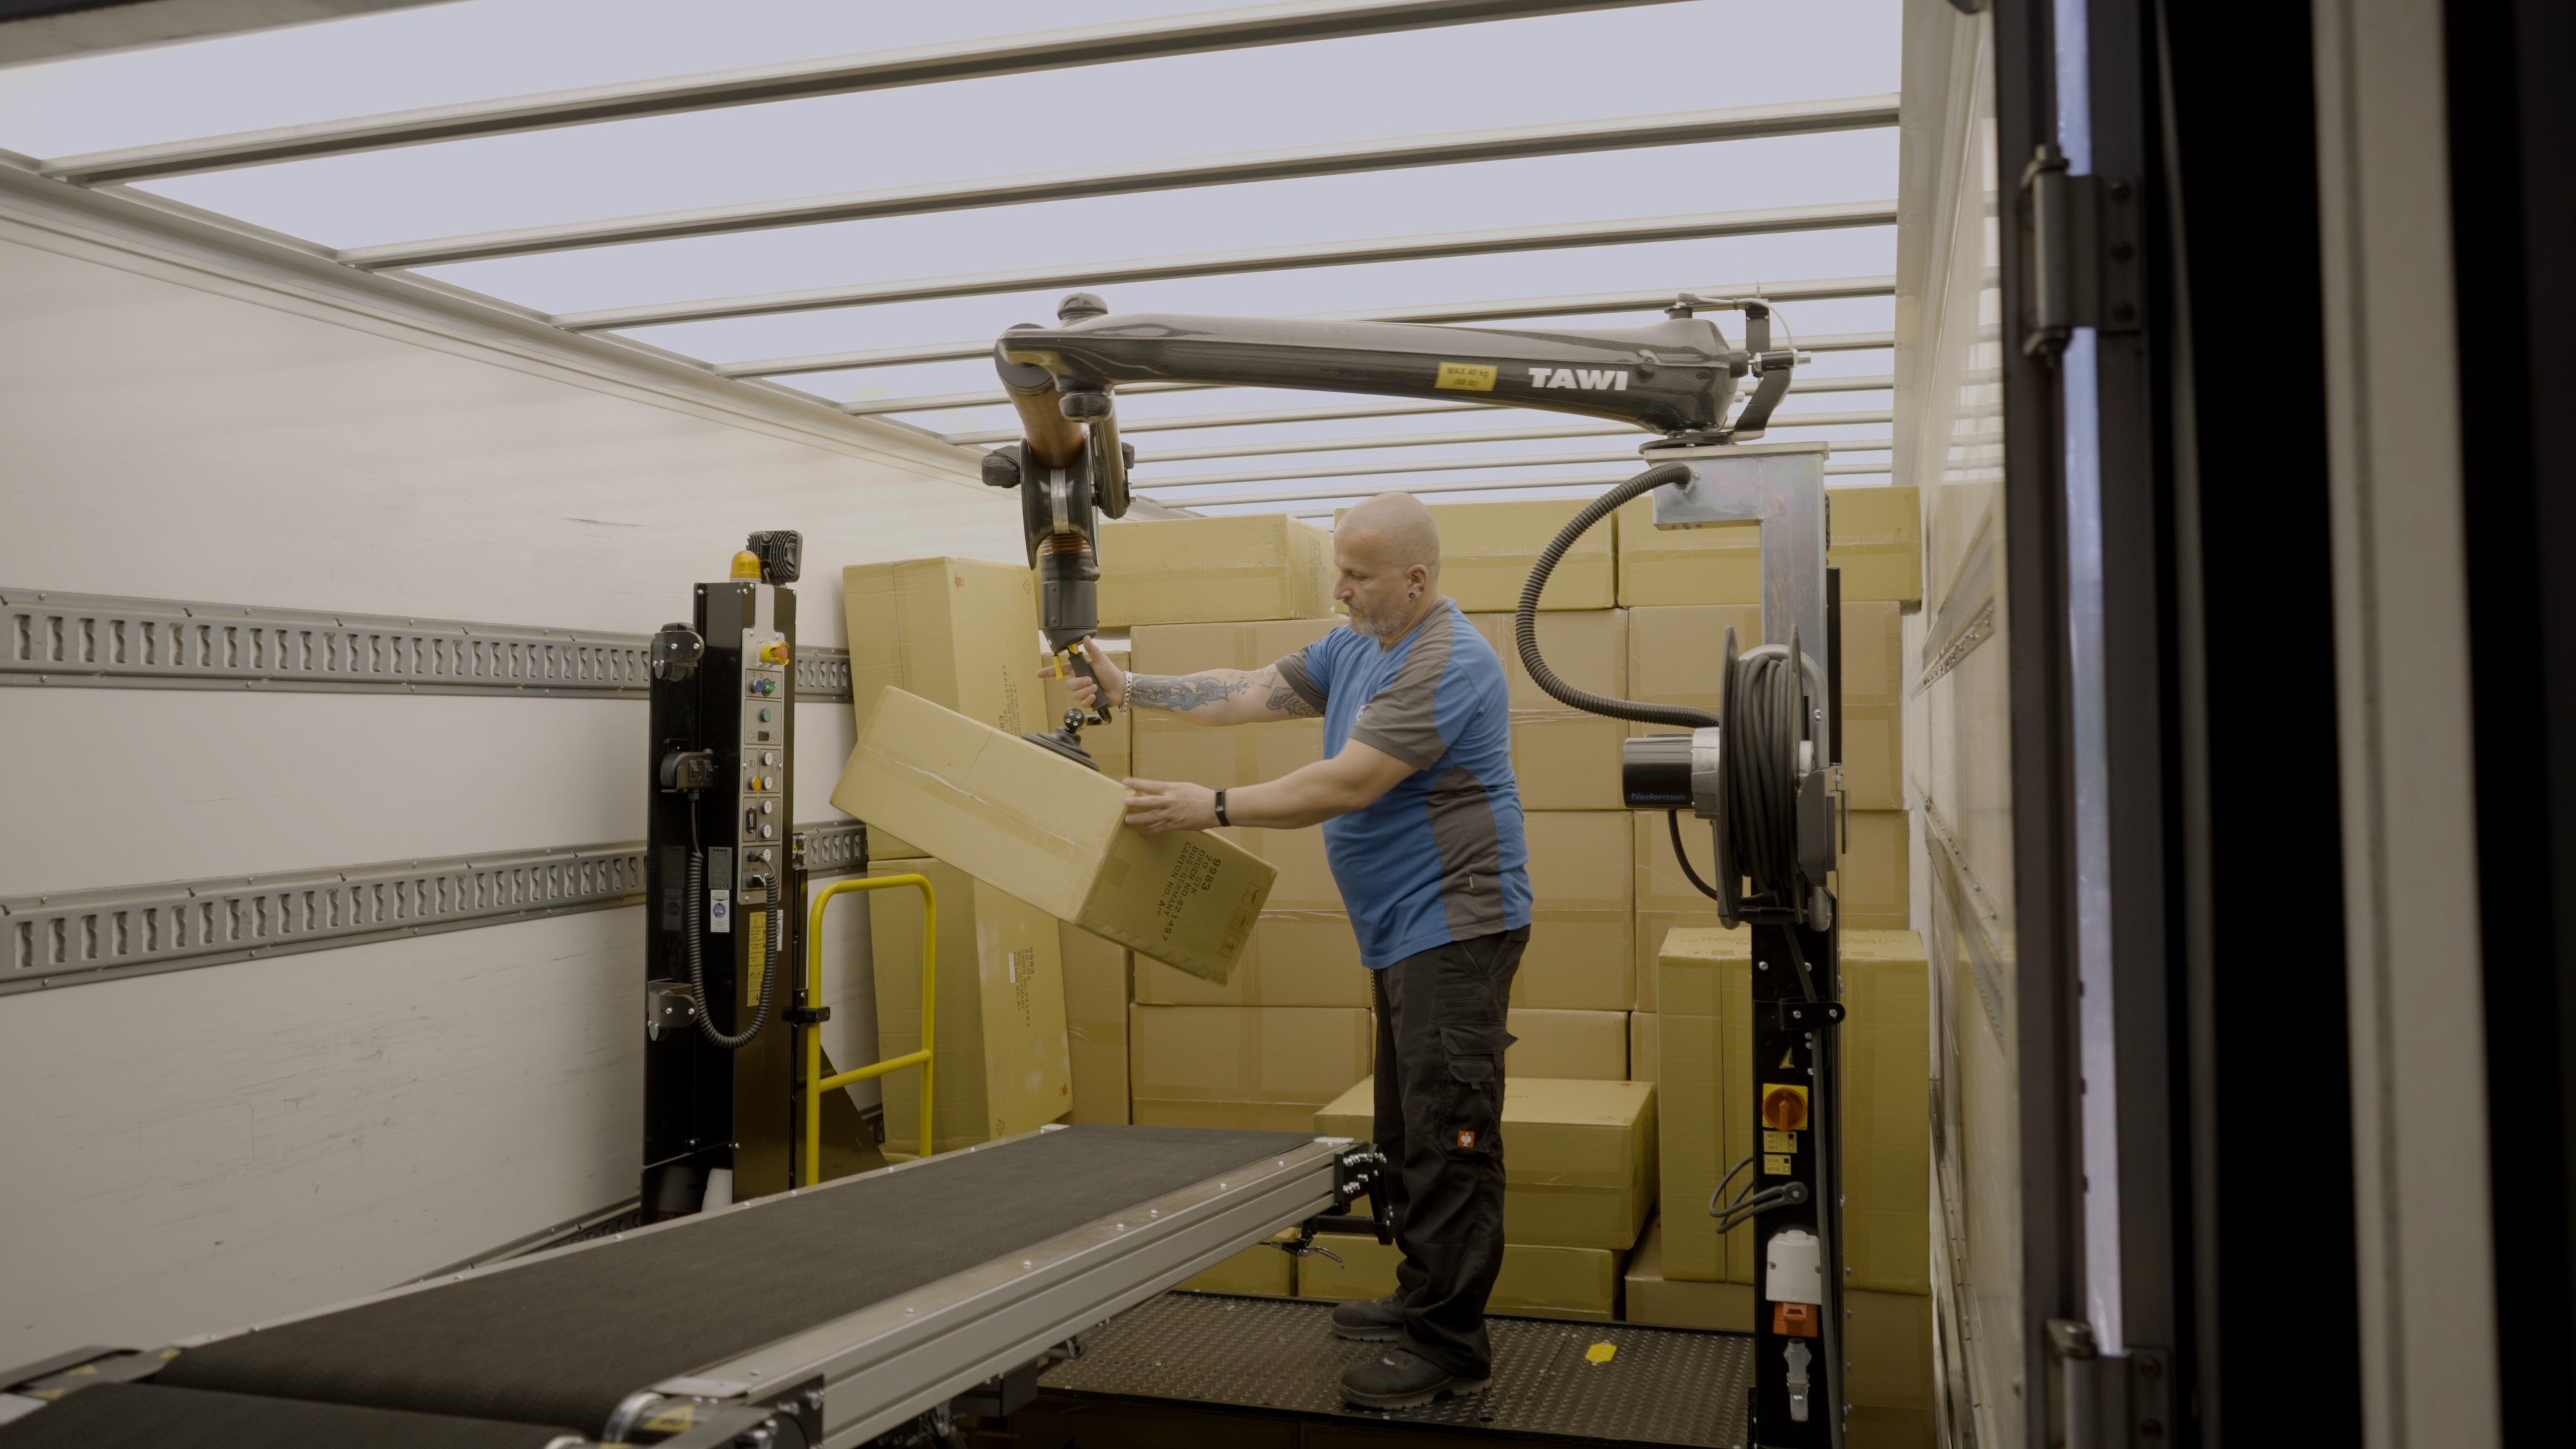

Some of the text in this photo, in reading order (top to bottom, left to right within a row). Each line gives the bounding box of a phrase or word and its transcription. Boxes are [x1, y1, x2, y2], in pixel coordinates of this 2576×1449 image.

[1447, 367, 1467, 375] MAX
[1479, 369, 1489, 379] kg
[1528, 367, 1629, 391] TAWI
[1631, 792, 1685, 800] Nederman
[1171, 841, 1191, 879] CARTON
[1189, 849, 1205, 880] ORDER
[1190, 854, 1212, 895] 20 STK
[1201, 858, 1221, 891] 9983
